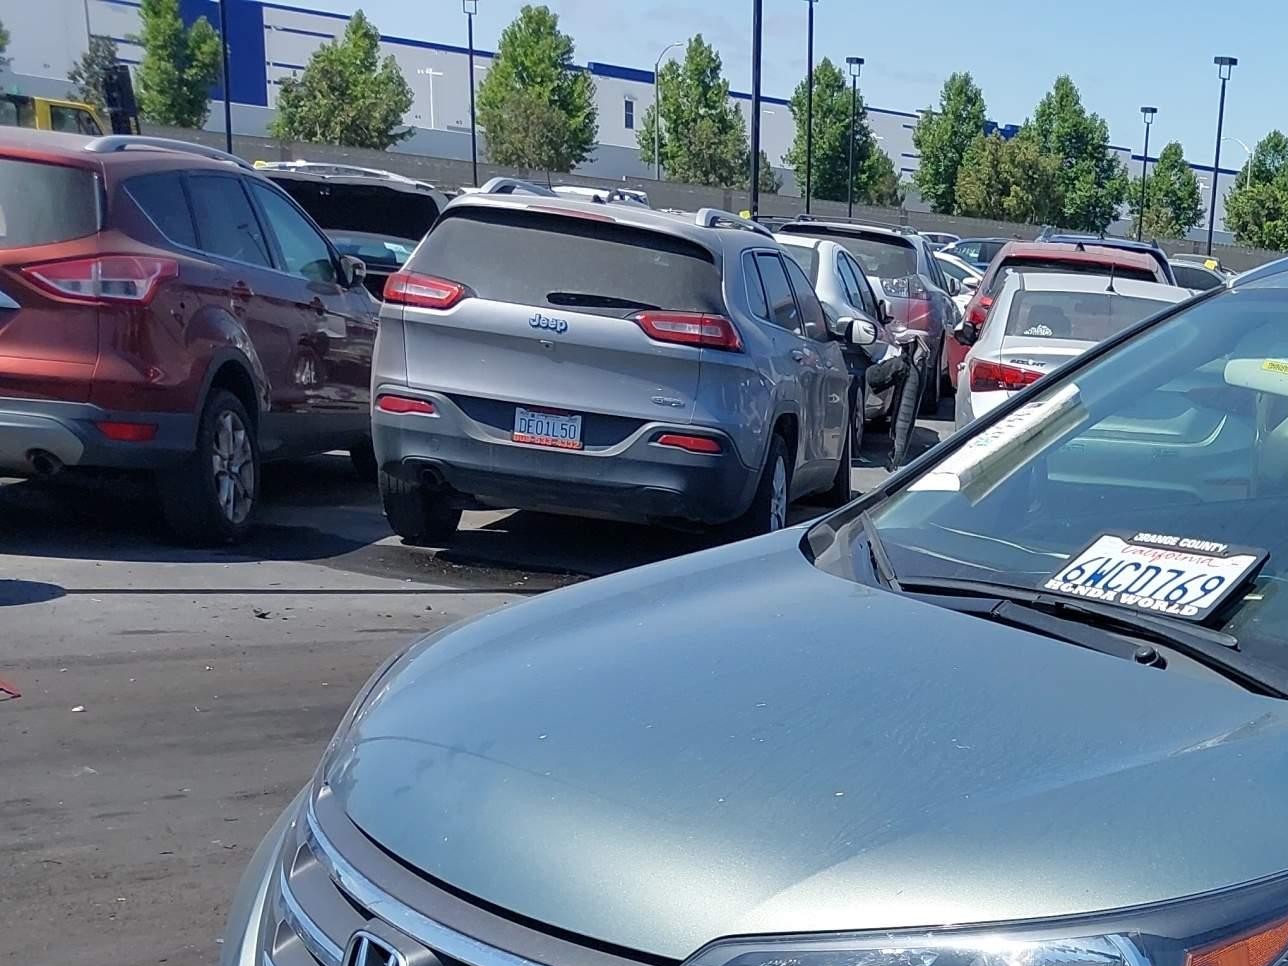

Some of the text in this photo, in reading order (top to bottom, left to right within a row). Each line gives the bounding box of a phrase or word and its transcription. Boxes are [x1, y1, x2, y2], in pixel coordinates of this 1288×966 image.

[528, 313, 568, 334] Jeep
[1134, 532, 1228, 553] ORANGE COUNTY
[1061, 556, 1226, 606] 6WCD769
[1044, 578, 1199, 617] HONDA WORLD
